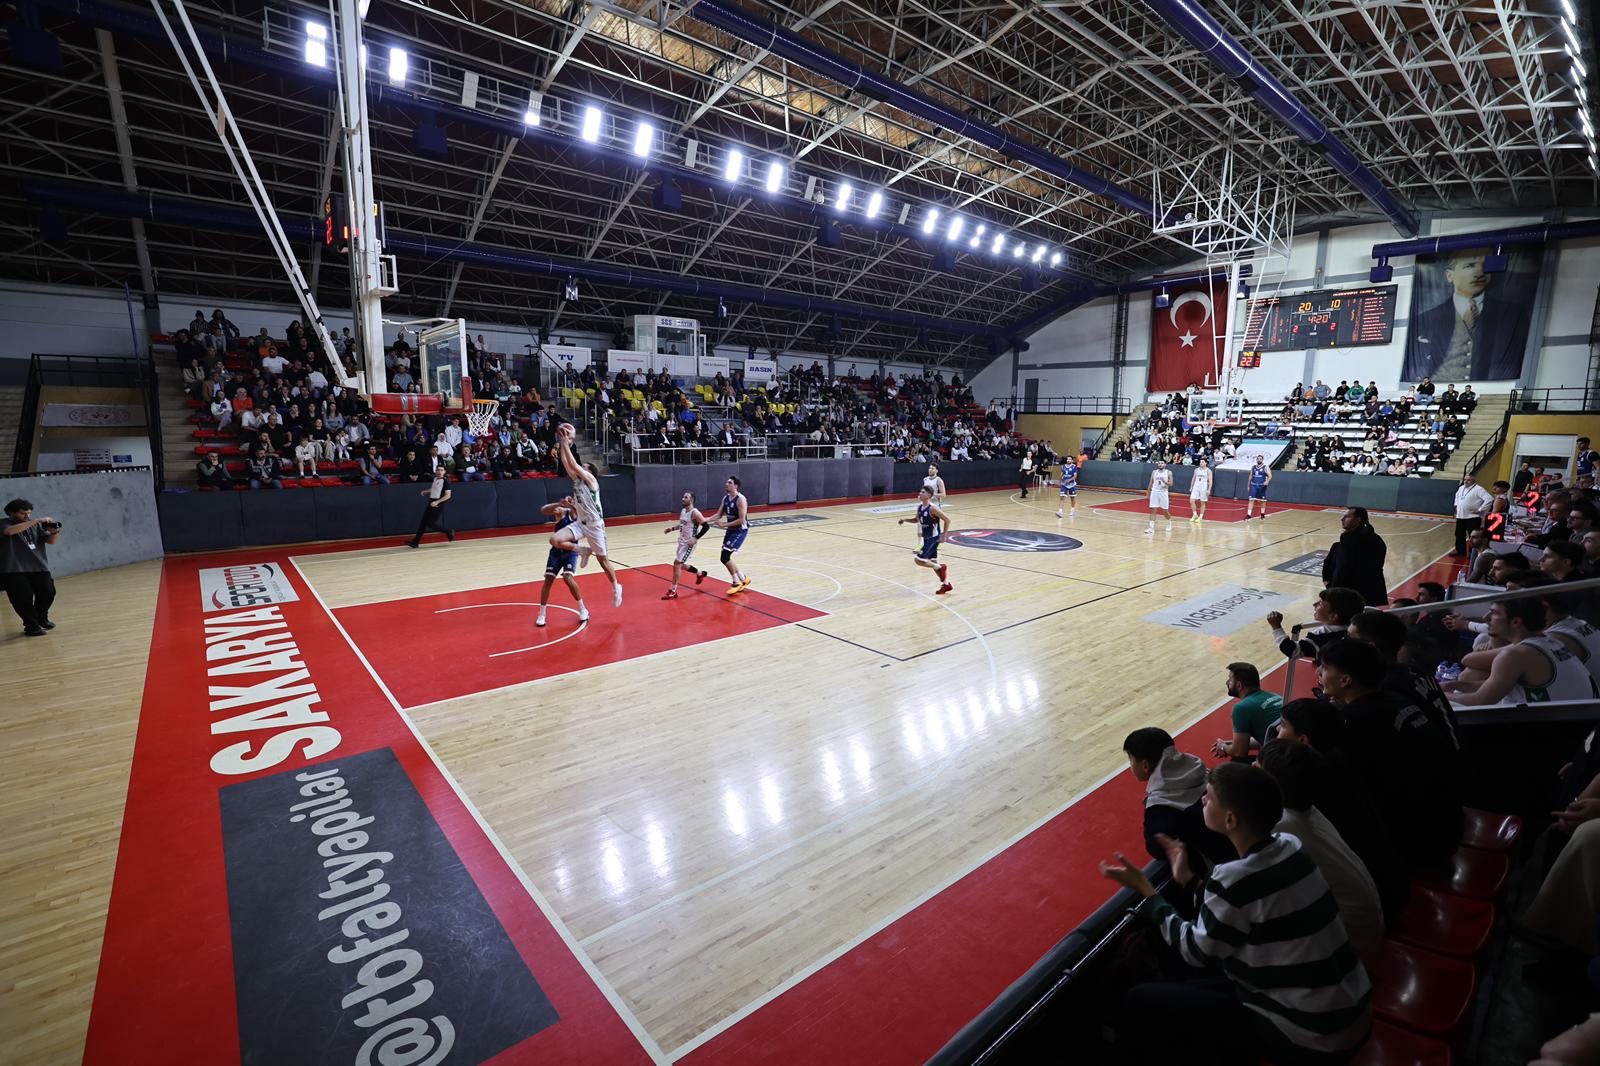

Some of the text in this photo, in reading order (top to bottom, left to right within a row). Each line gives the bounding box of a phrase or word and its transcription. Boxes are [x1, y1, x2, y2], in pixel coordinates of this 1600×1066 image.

[1298, 302, 1312, 312] 20
[1330, 299, 1341, 309] 10
[1308, 314, 1329, 324] 4:20
[1239, 357, 1253, 366] 22
[1171, 609, 1227, 628] BBVA
[203, 605, 343, 775] SAKARYA
[289, 767, 456, 1066] @tbfaltyapilar
